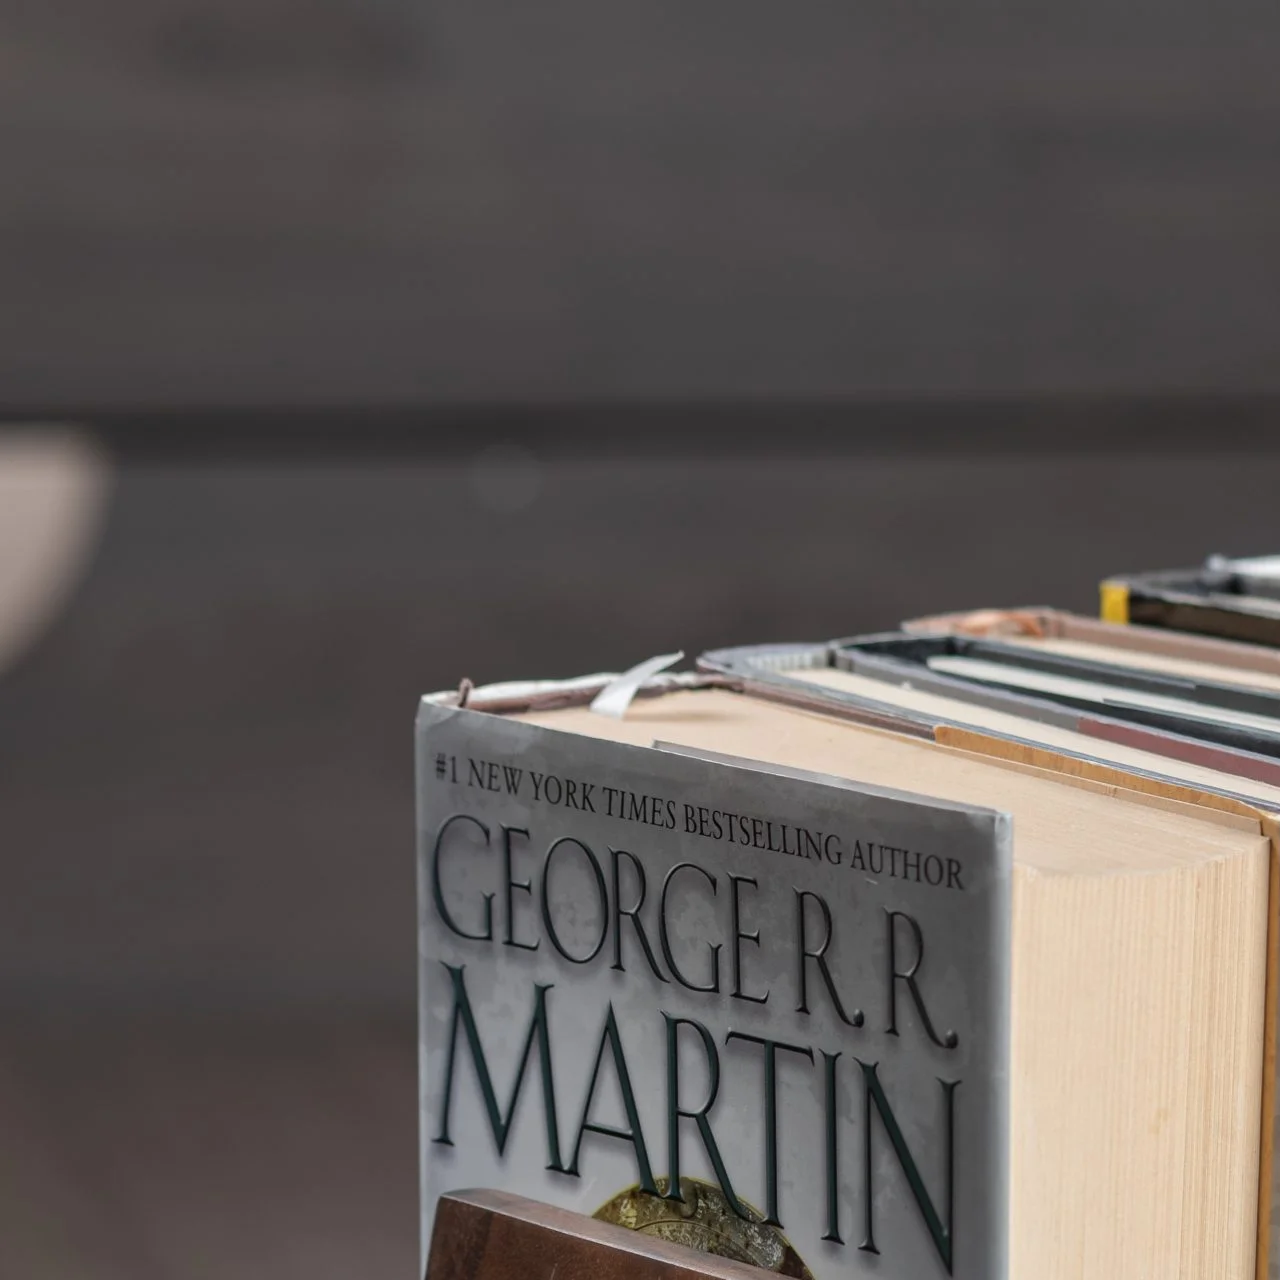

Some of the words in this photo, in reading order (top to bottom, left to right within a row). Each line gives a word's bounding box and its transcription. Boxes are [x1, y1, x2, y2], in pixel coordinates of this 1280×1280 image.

[432, 813, 770, 1004] GEORGE
[792, 885, 865, 1029] R.
[883, 906, 960, 1050] R.
[435, 752, 459, 785] #1
[467, 758, 523, 797] NEW
[529, 771, 596, 813] YORK
[602, 786, 677, 830] TIMES
[684, 804, 843, 866] BESTSELLING
[850, 839, 965, 890] AUTHOR
[431, 959, 963, 1279] MARTIN
